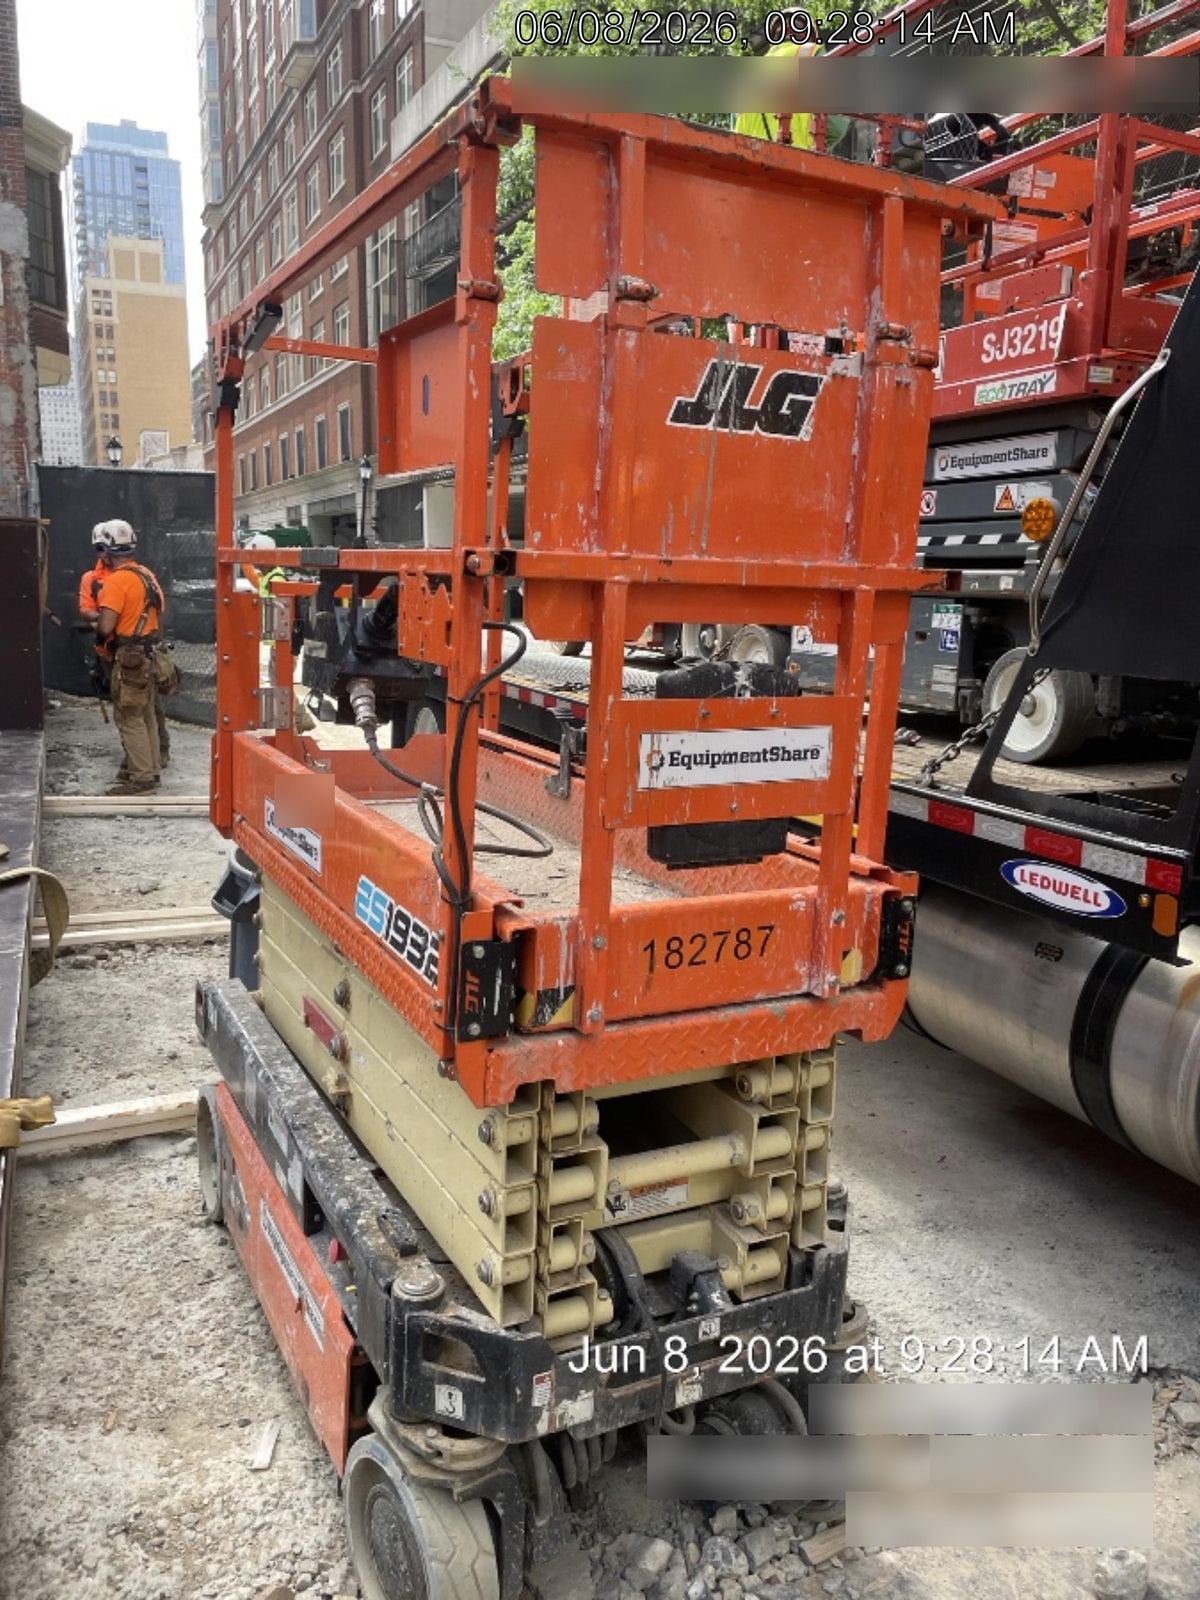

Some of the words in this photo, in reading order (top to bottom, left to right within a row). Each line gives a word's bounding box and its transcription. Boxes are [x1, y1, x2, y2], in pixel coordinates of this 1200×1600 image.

[981, 314, 1062, 364] SJ3219
[667, 359, 829, 440] JLG
[976, 373, 1055, 403] ECOTRAY
[950, 447, 1048, 470] EquipmentShare
[668, 746, 821, 770] EquipmentShare
[1020, 868, 1102, 907] LEDWELL
[643, 924, 775, 973] 182787
[465, 969, 481, 1014] JLG
